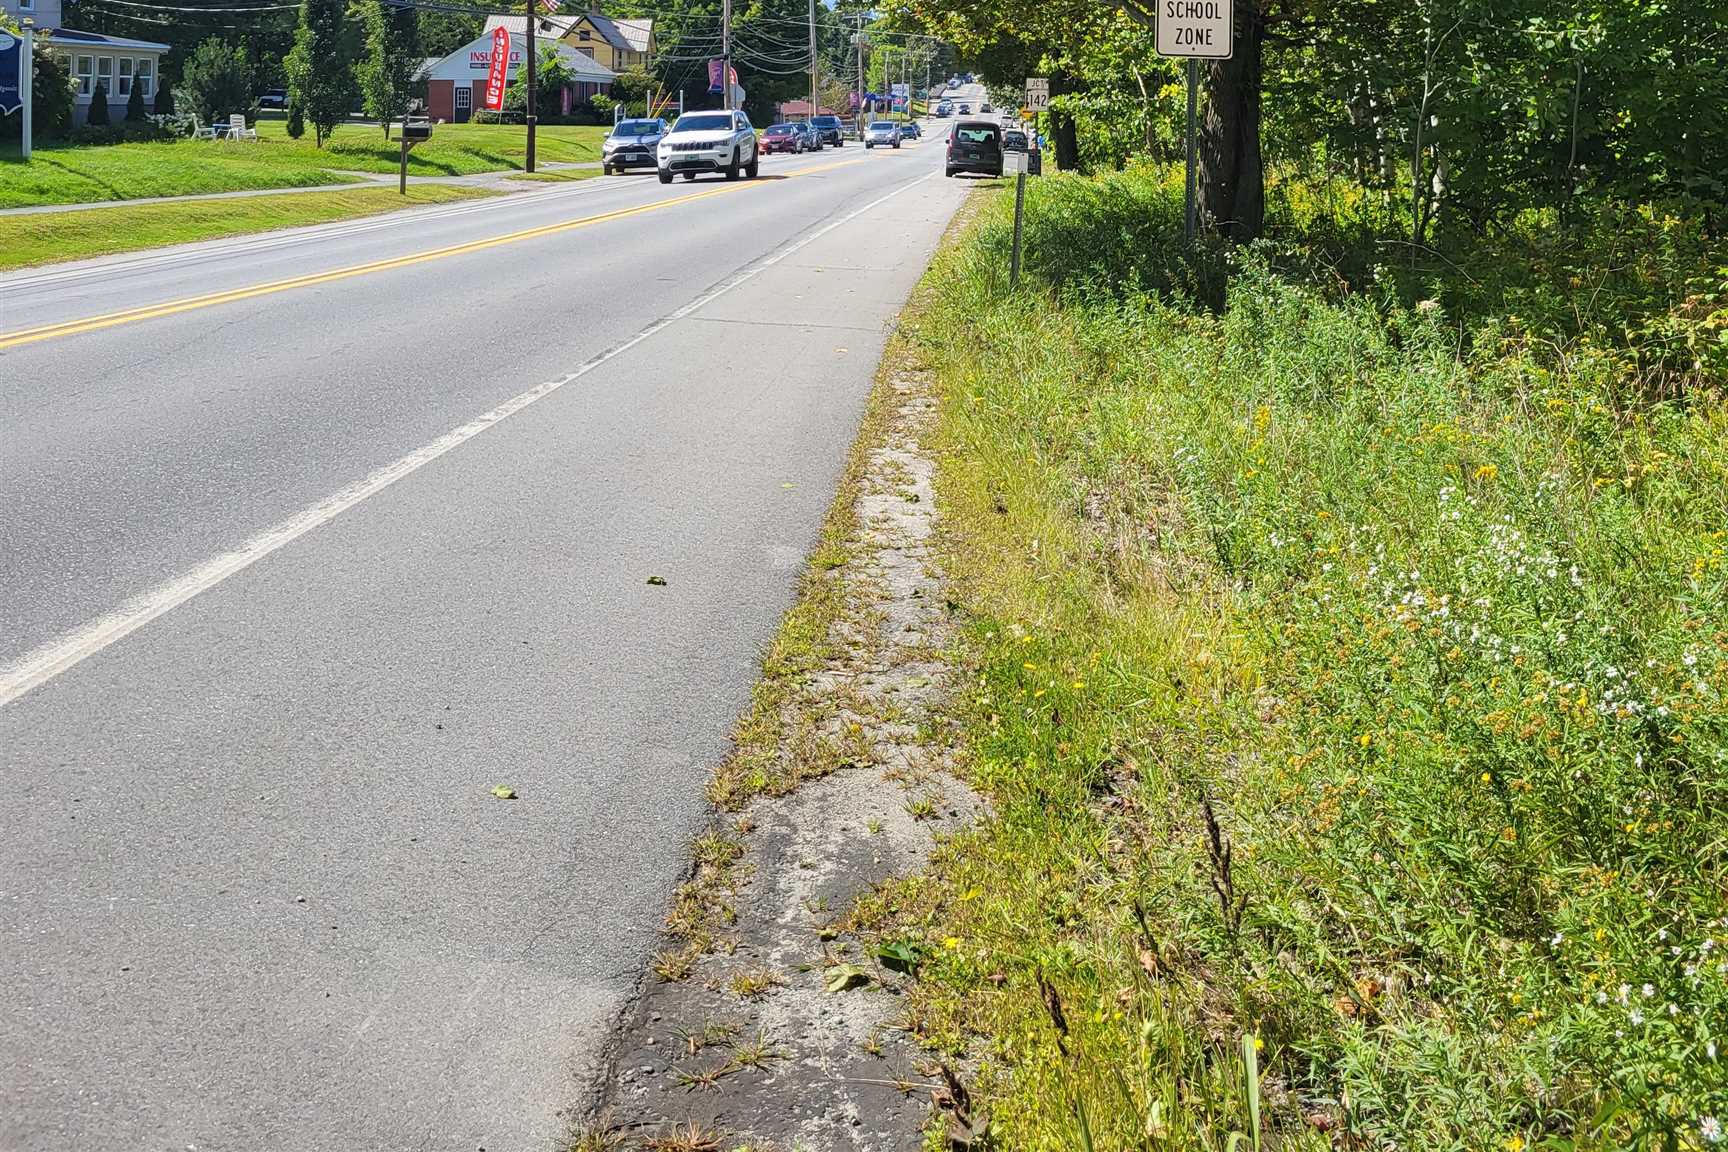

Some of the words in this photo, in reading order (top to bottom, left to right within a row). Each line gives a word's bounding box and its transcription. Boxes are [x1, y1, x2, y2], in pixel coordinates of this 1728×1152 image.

[1166, 0, 1222, 20] SCHOOL
[1175, 27, 1213, 45] ZONE
[470, 51, 521, 62] INSUCE
[1031, 79, 1046, 89] JCT
[1030, 94, 1047, 107] 142
